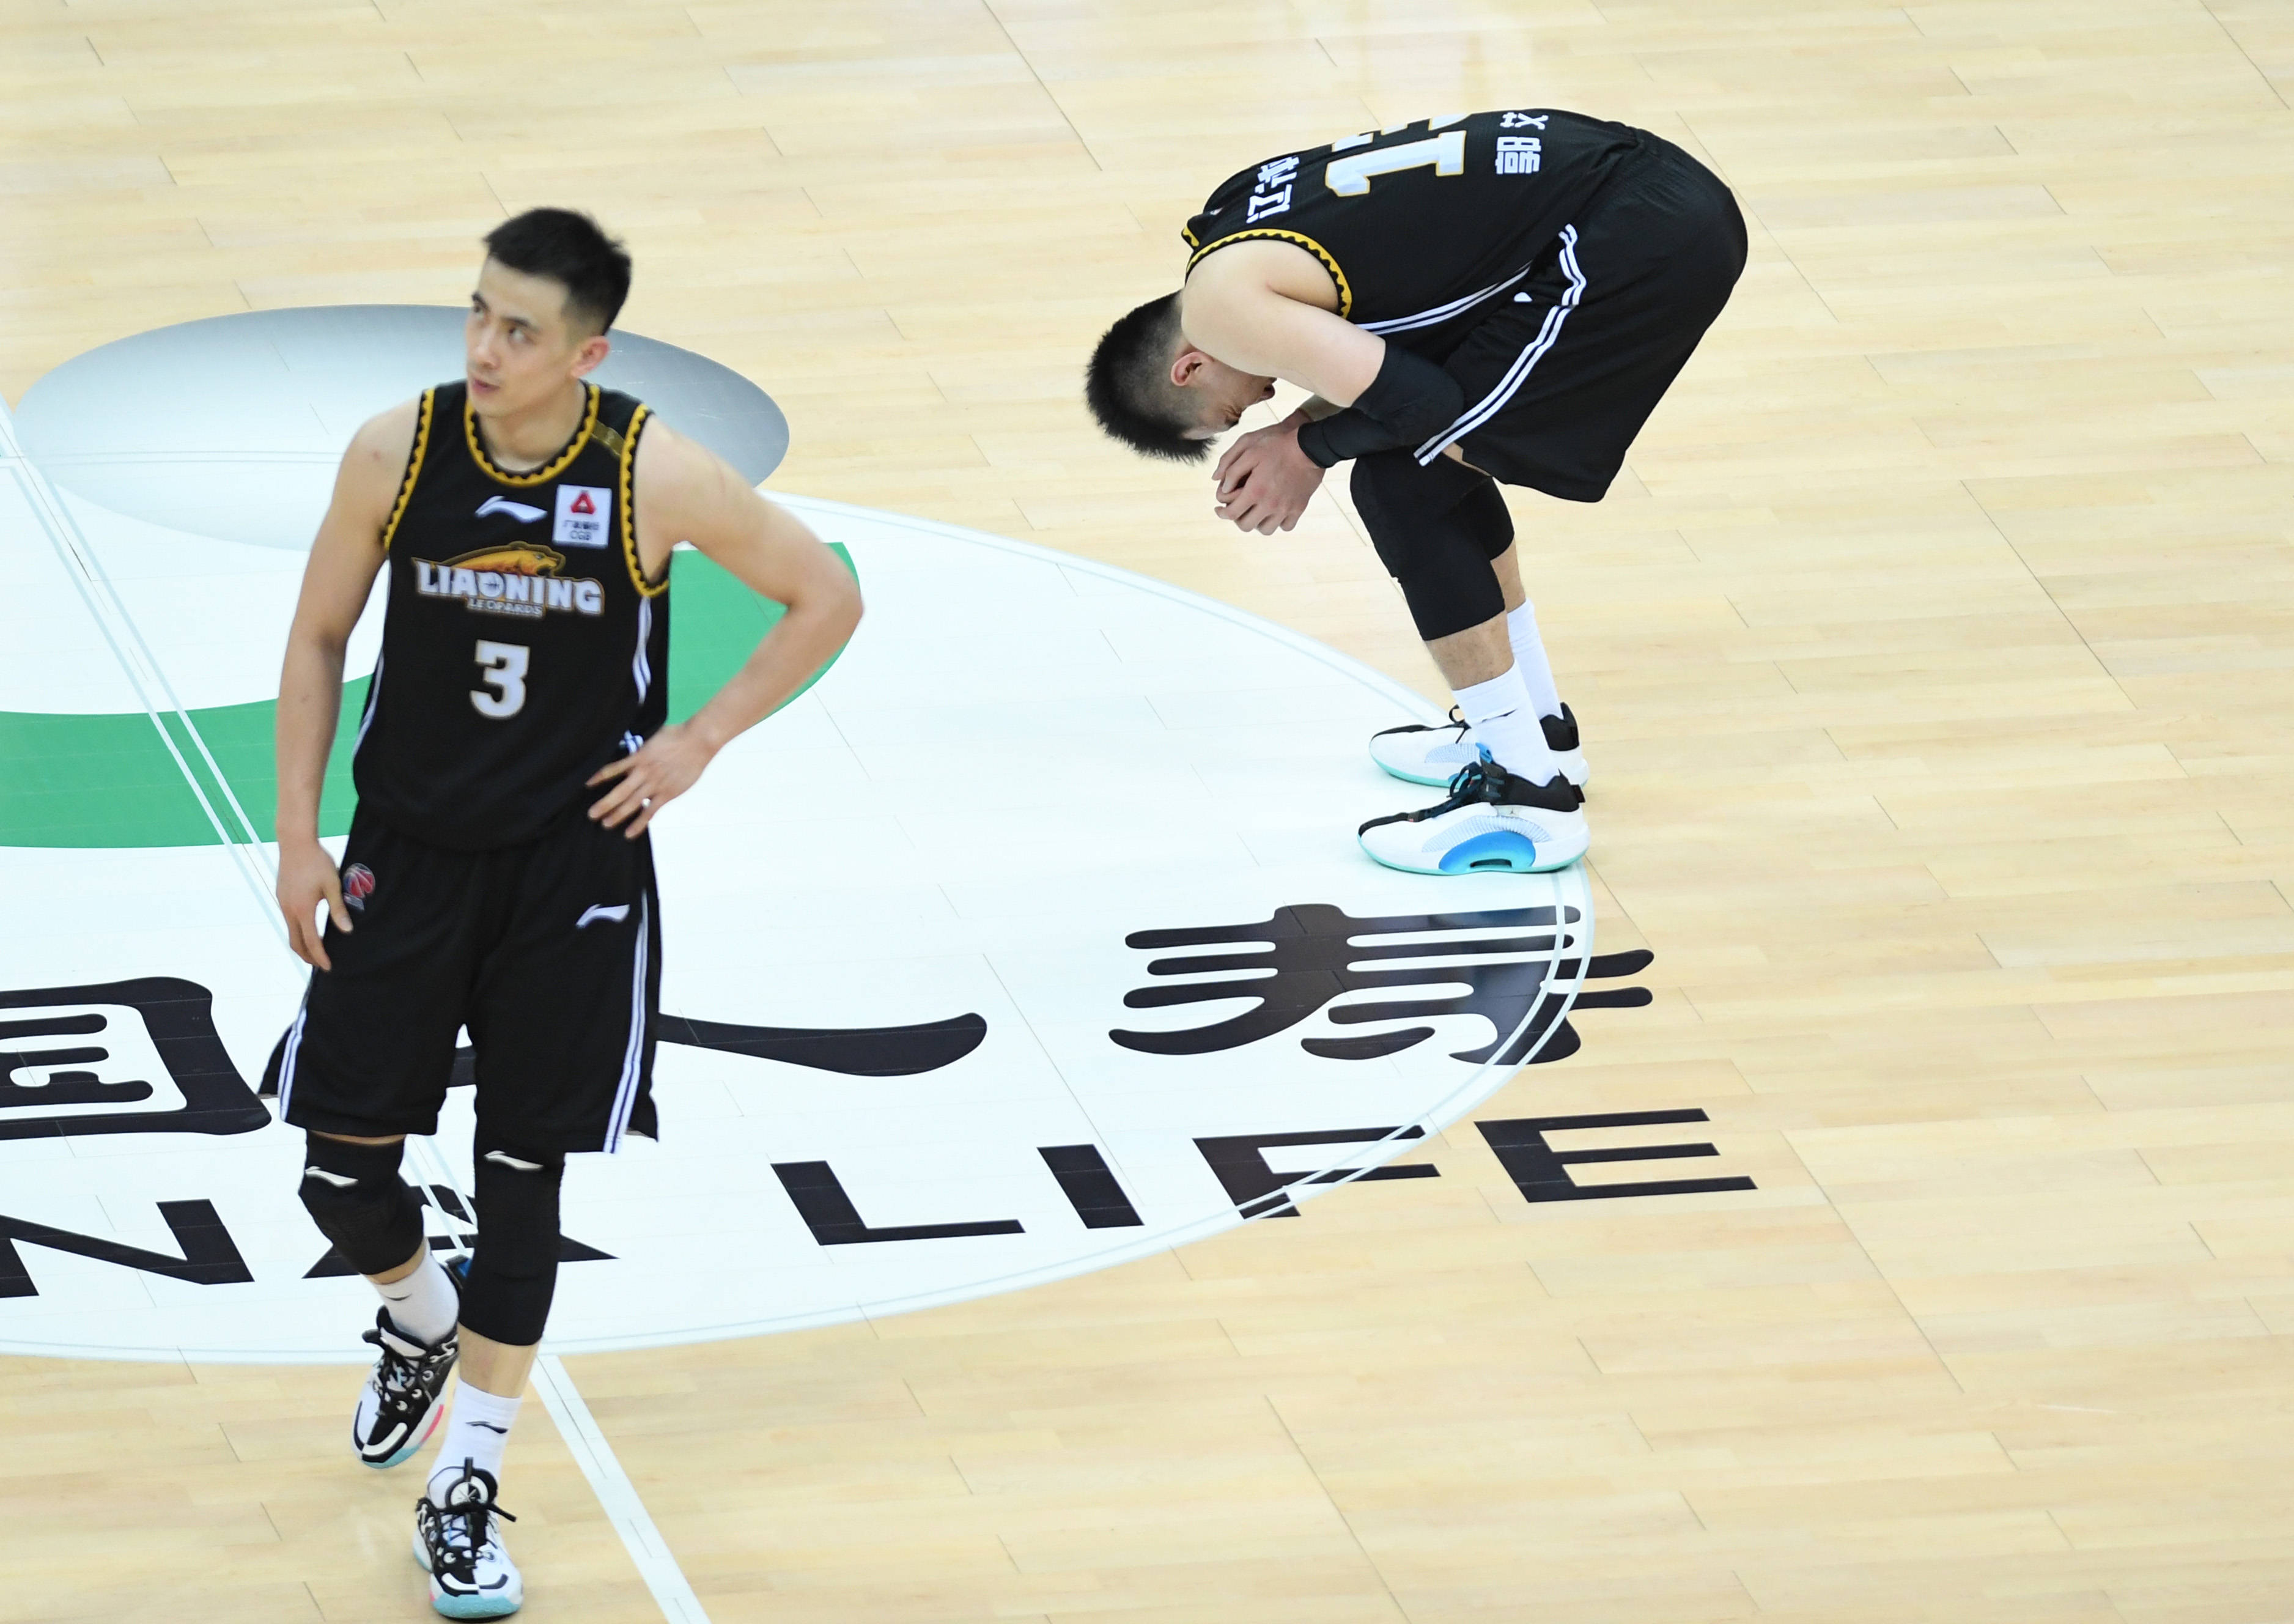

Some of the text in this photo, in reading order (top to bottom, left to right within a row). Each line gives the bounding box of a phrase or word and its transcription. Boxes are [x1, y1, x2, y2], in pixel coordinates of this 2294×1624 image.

[414, 559, 603, 615] LIAONING
[470, 639, 530, 720] 3
[770, 1107, 1758, 1246] LIFE
